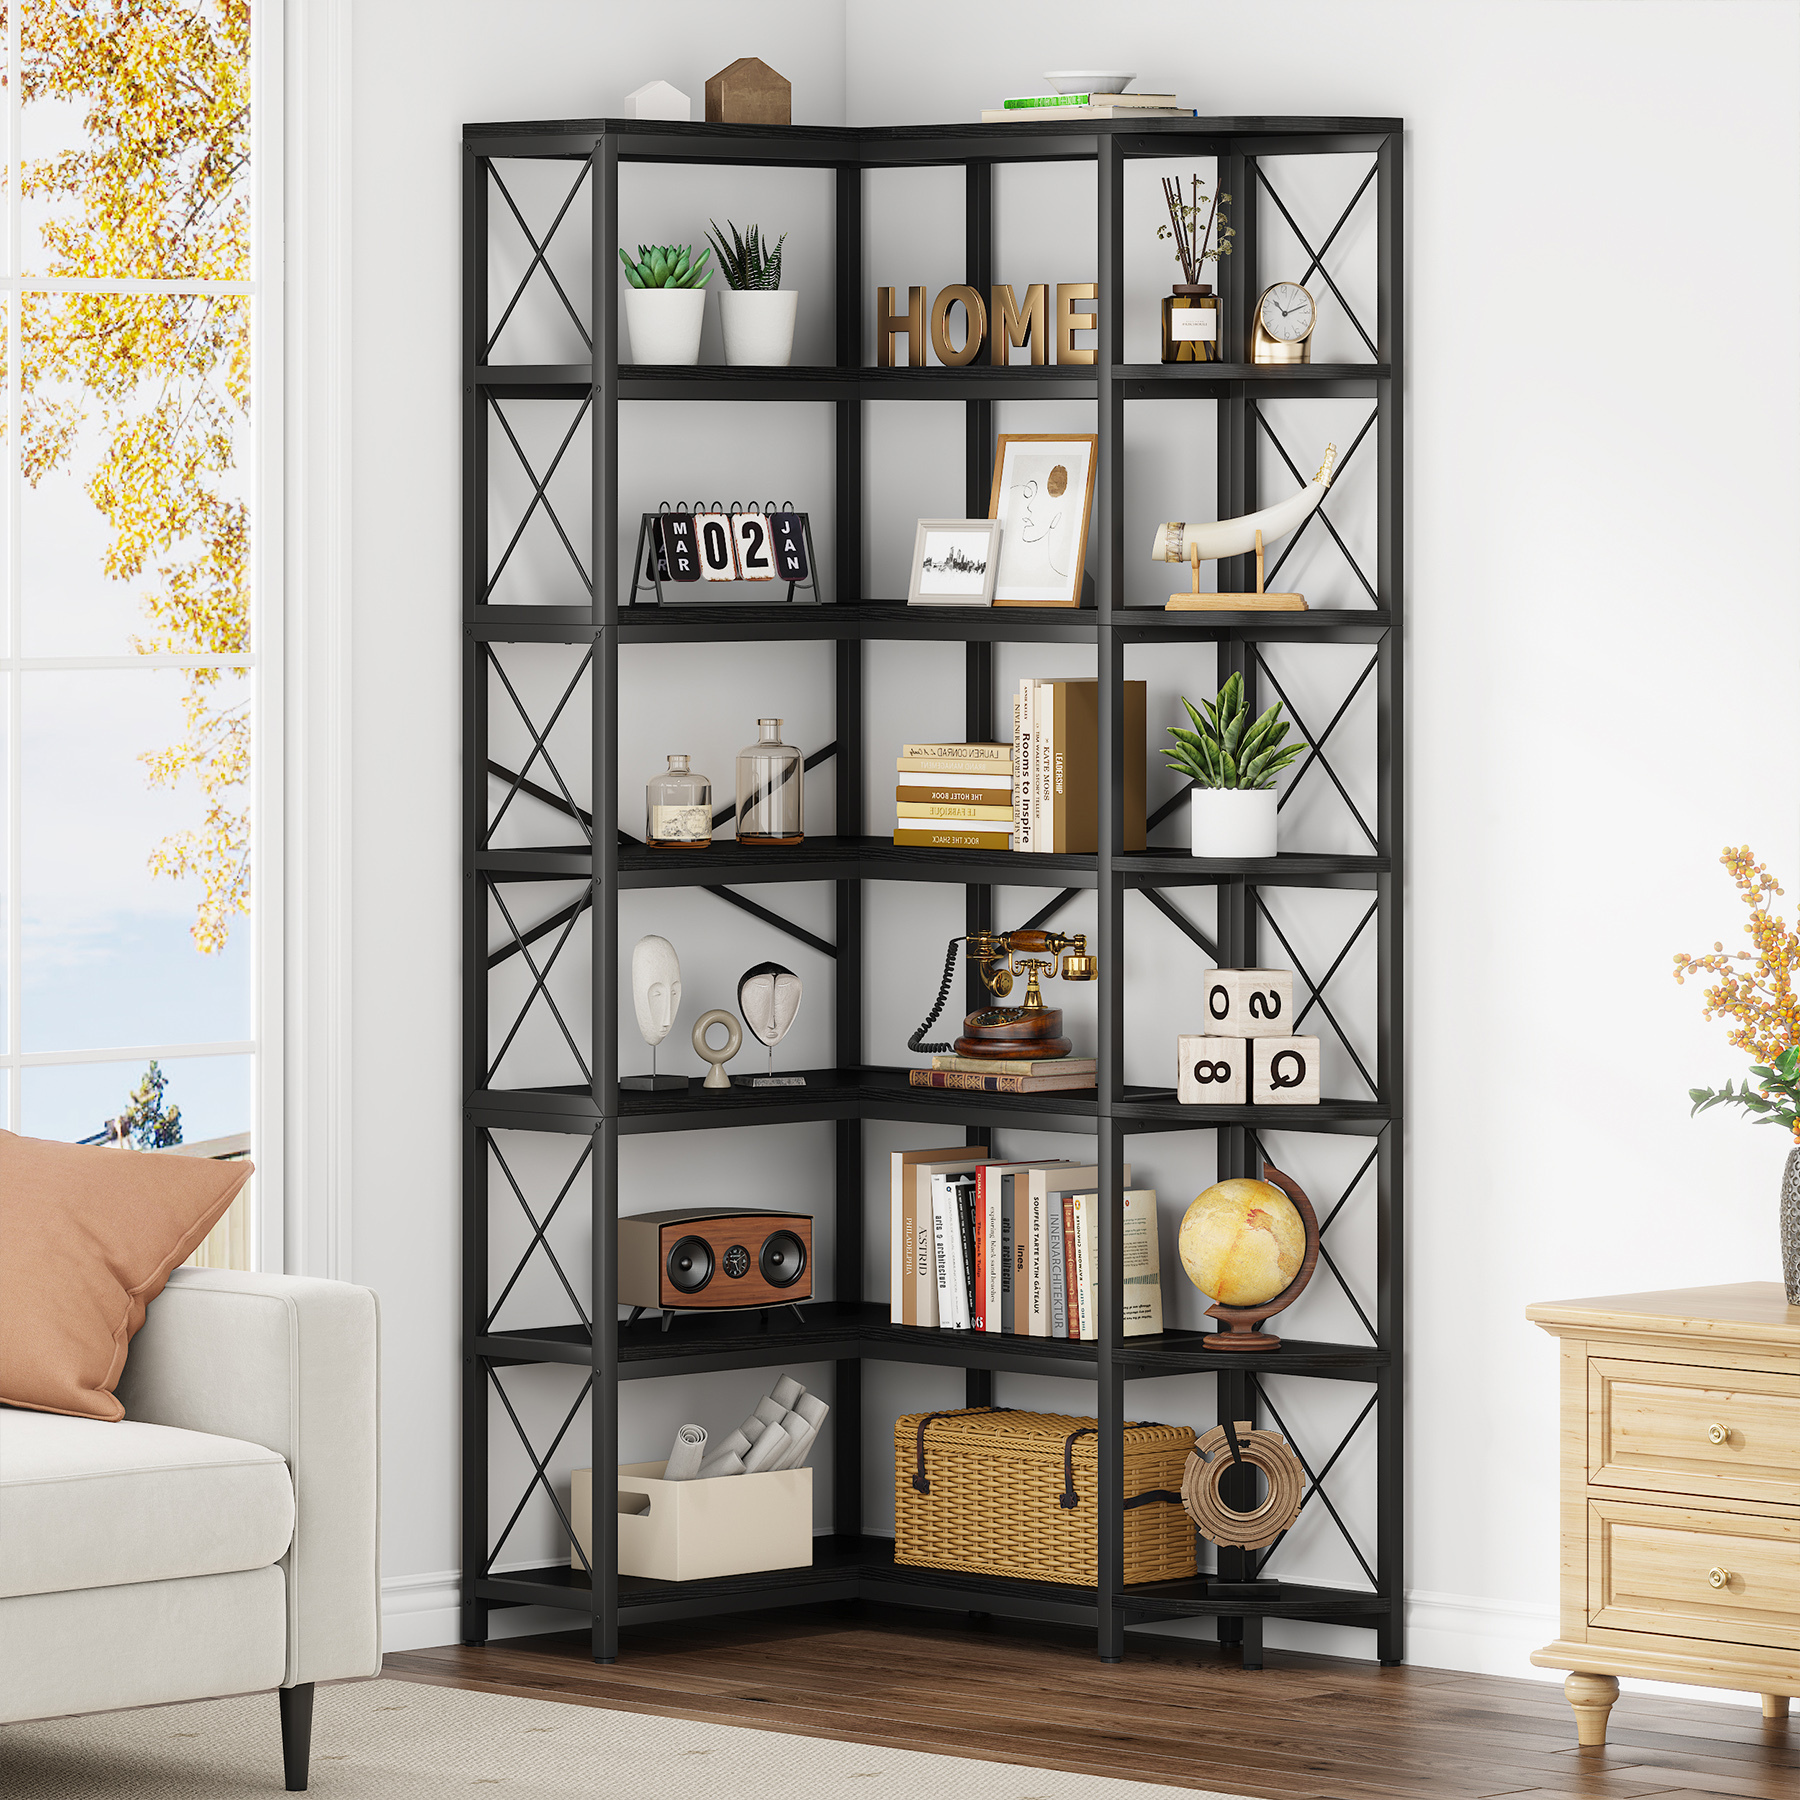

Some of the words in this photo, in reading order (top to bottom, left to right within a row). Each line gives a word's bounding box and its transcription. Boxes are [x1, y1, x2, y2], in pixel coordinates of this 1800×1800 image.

[877, 283, 1098, 367] HOME
[672, 521, 691, 571] MAR
[780, 520, 800, 570] JAN
[1022, 733, 1030, 777] Rooms
[1055, 752, 1063, 795] LEADERSHIP
[1022, 781, 1030, 795] to
[1020, 799, 1031, 844] Inspire
[1194, 1059, 1231, 1084] 8
[935, 1215, 943, 1231] arts
[1002, 1217, 1010, 1233] arts
[918, 1226, 928, 1277] ASTRID
[937, 1241, 947, 1289] architecture
[1002, 1243, 1011, 1293] architecture
[1017, 1244, 1025, 1272] lines.
[1050, 1213, 1063, 1329] INNENARCHITEKTUR
